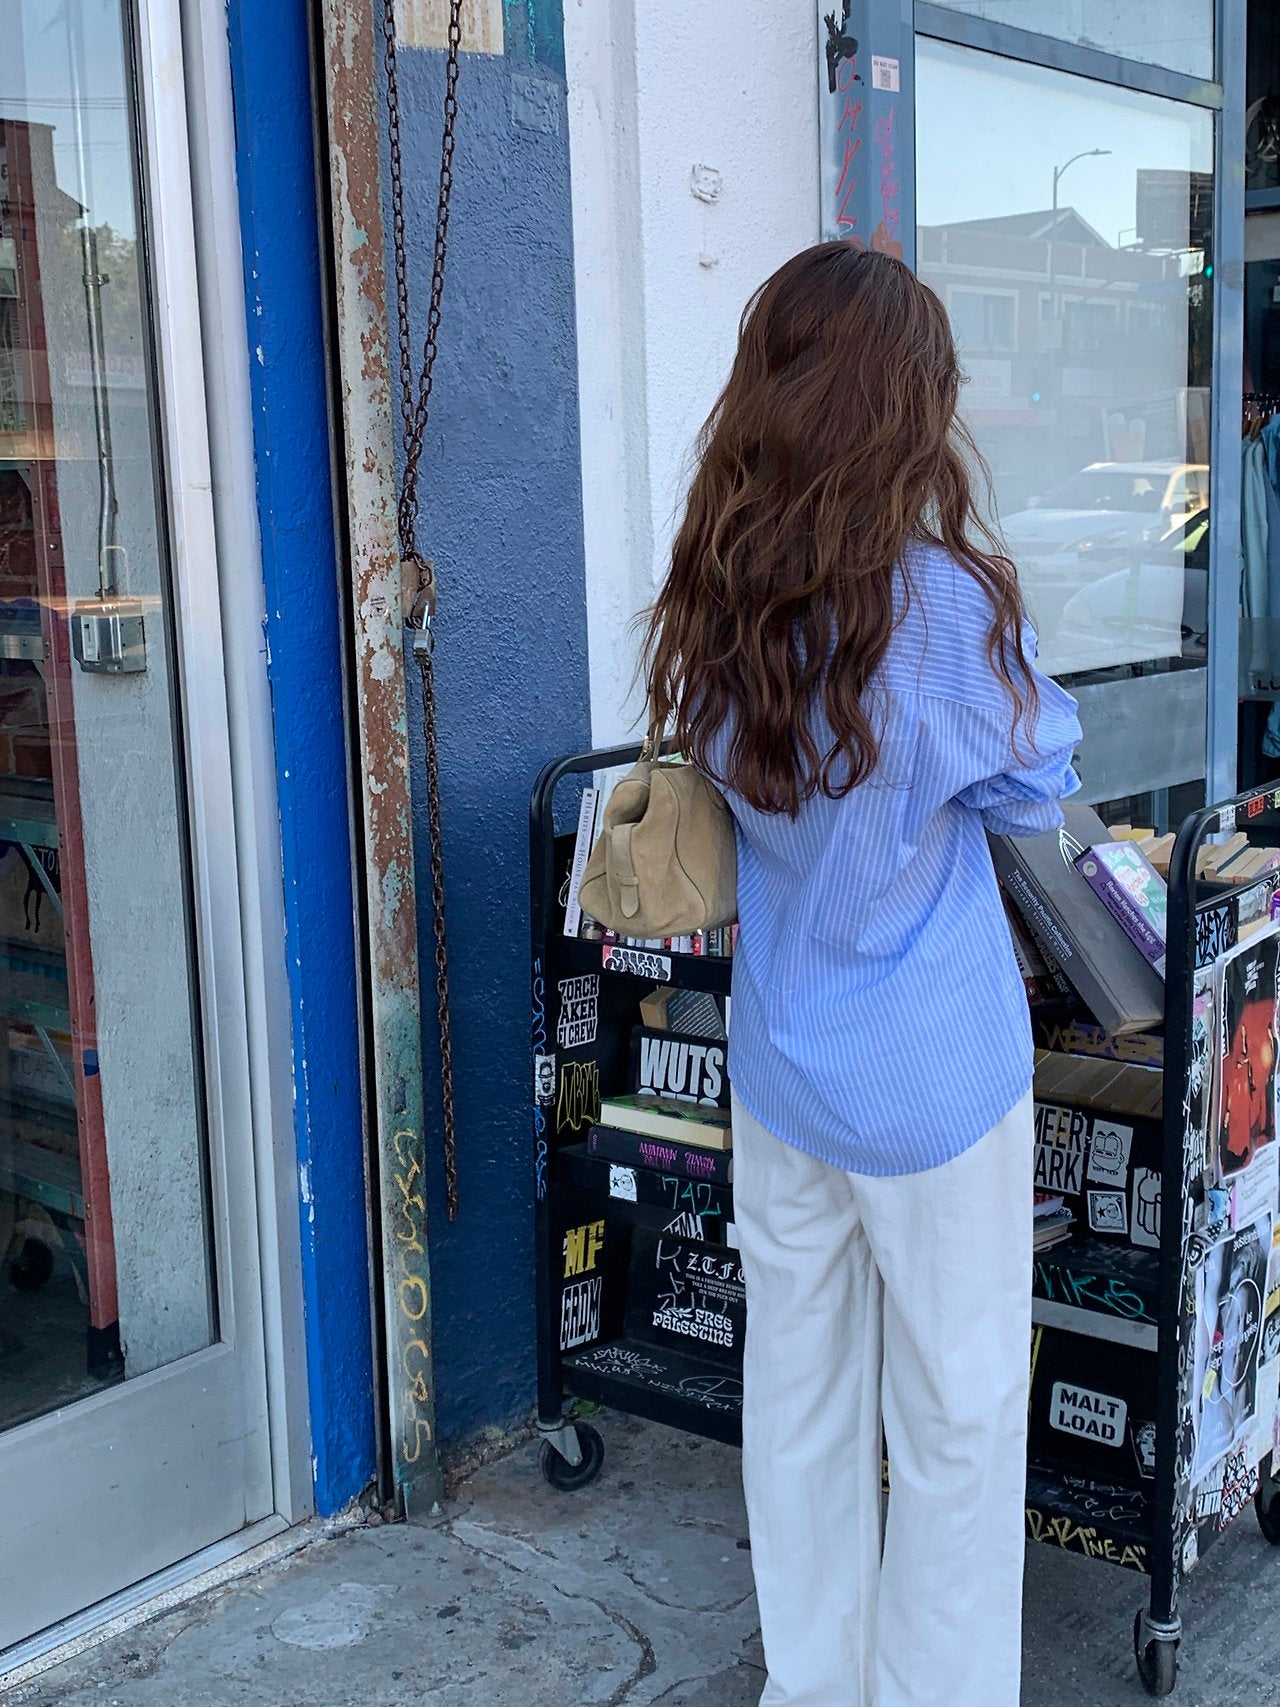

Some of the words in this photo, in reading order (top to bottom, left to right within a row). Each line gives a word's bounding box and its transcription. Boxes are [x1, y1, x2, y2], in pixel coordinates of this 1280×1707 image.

[582, 801, 592, 833] HABITS
[575, 849, 586, 881] HOUSE
[1020, 882, 1040, 908] Security
[1037, 905, 1054, 928] Pacific
[1050, 925, 1073, 957] Collection
[1106, 881, 1122, 901] Horton
[1120, 899, 1139, 923] Hatches
[1138, 922, 1146, 933] the
[1145, 932, 1156, 944] Egg
[641, 1037, 723, 1098] WUTS
[652, 1311, 734, 1348] PALESTINE
[695, 1308, 733, 1332] FREE
[1060, 1388, 1120, 1419] MALT
[1058, 1410, 1116, 1441] LOAD
